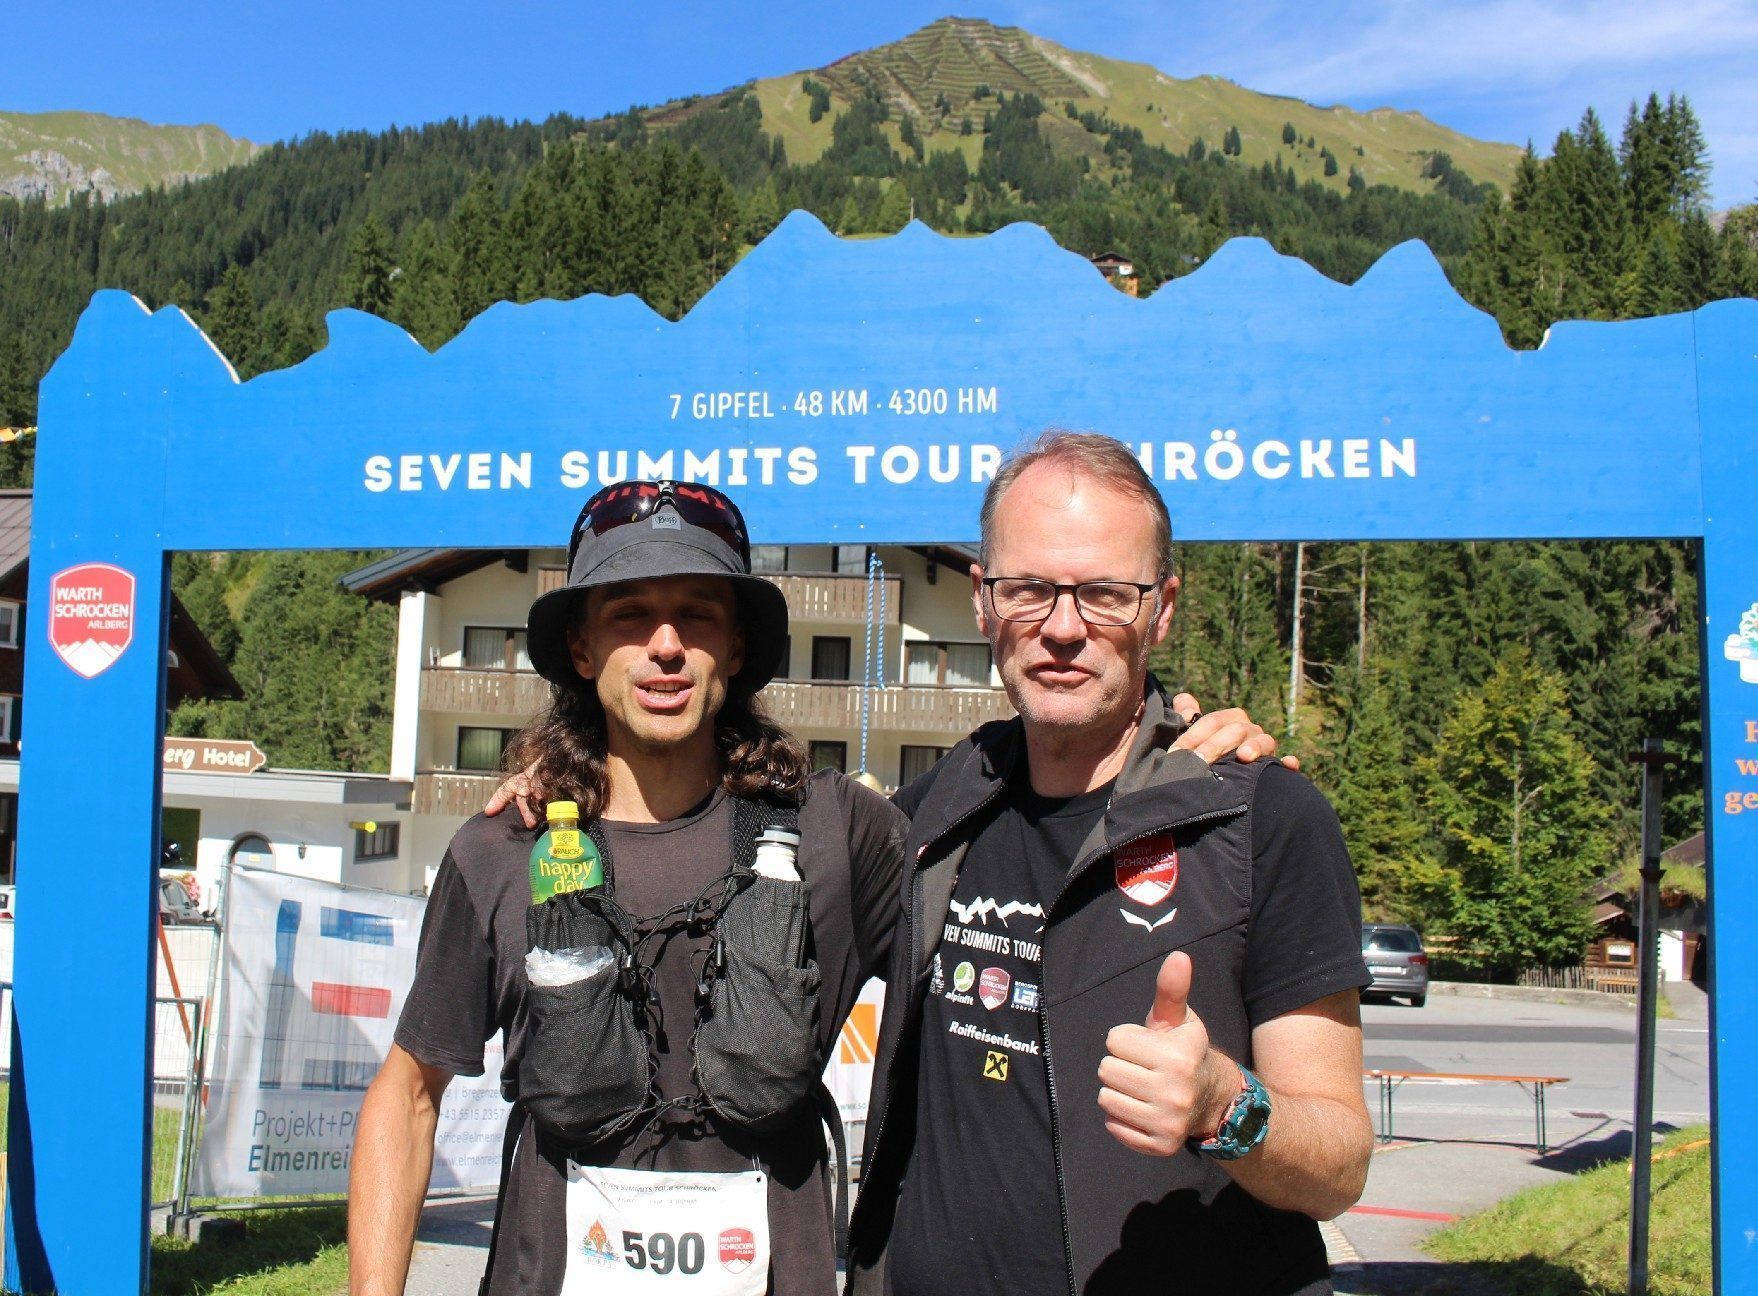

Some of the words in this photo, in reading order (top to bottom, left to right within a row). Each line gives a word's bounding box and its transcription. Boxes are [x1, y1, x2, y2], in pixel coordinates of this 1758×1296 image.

[670, 395, 680, 419] 7
[692, 392, 774, 418] GIPFEL
[794, 391, 823, 416] 48
[831, 390, 869, 415] KM
[888, 388, 948, 415] 4300
[958, 387, 997, 413] HM
[364, 452, 532, 492] SEVEN
[560, 447, 818, 489] SUMMITS
[847, 445, 1002, 483] TOUR
[56, 587, 103, 601] WARTH
[87, 619, 128, 630] ARLBERG
[202, 747, 251, 768] Hotel
[556, 847, 580, 855] RAUCH
[539, 857, 597, 881] happy
[960, 928, 1010, 955] SUMMITS
[948, 1020, 1040, 1056] Raiffeisenbank
[248, 1143, 350, 1172] Elmenrei
[622, 1230, 705, 1275] 590
